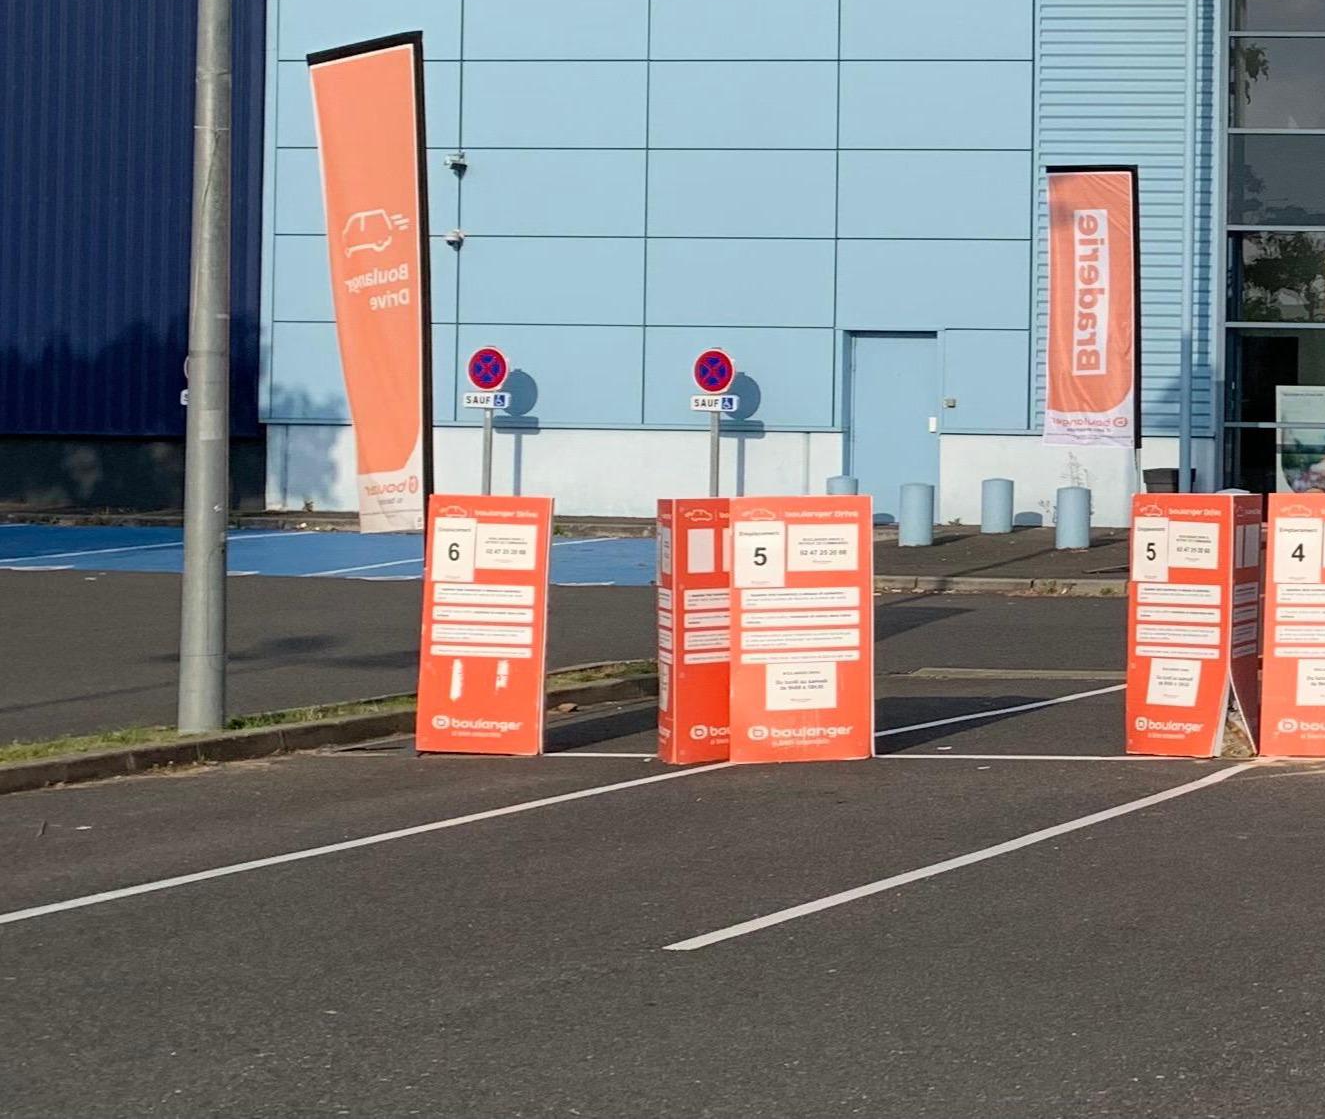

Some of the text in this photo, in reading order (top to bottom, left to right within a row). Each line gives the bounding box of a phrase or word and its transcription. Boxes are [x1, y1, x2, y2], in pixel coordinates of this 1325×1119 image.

[466, 395, 491, 405] SAUF
[694, 398, 720, 408] SAUF
[448, 542, 460, 562] 6
[753, 547, 768, 566] 5
[1146, 542, 1157, 561] 5
[1291, 543, 1305, 562] 4
[451, 717, 524, 732] boulanger
[771, 726, 854, 738] boulanger
[1148, 720, 1204, 734] boulanger
